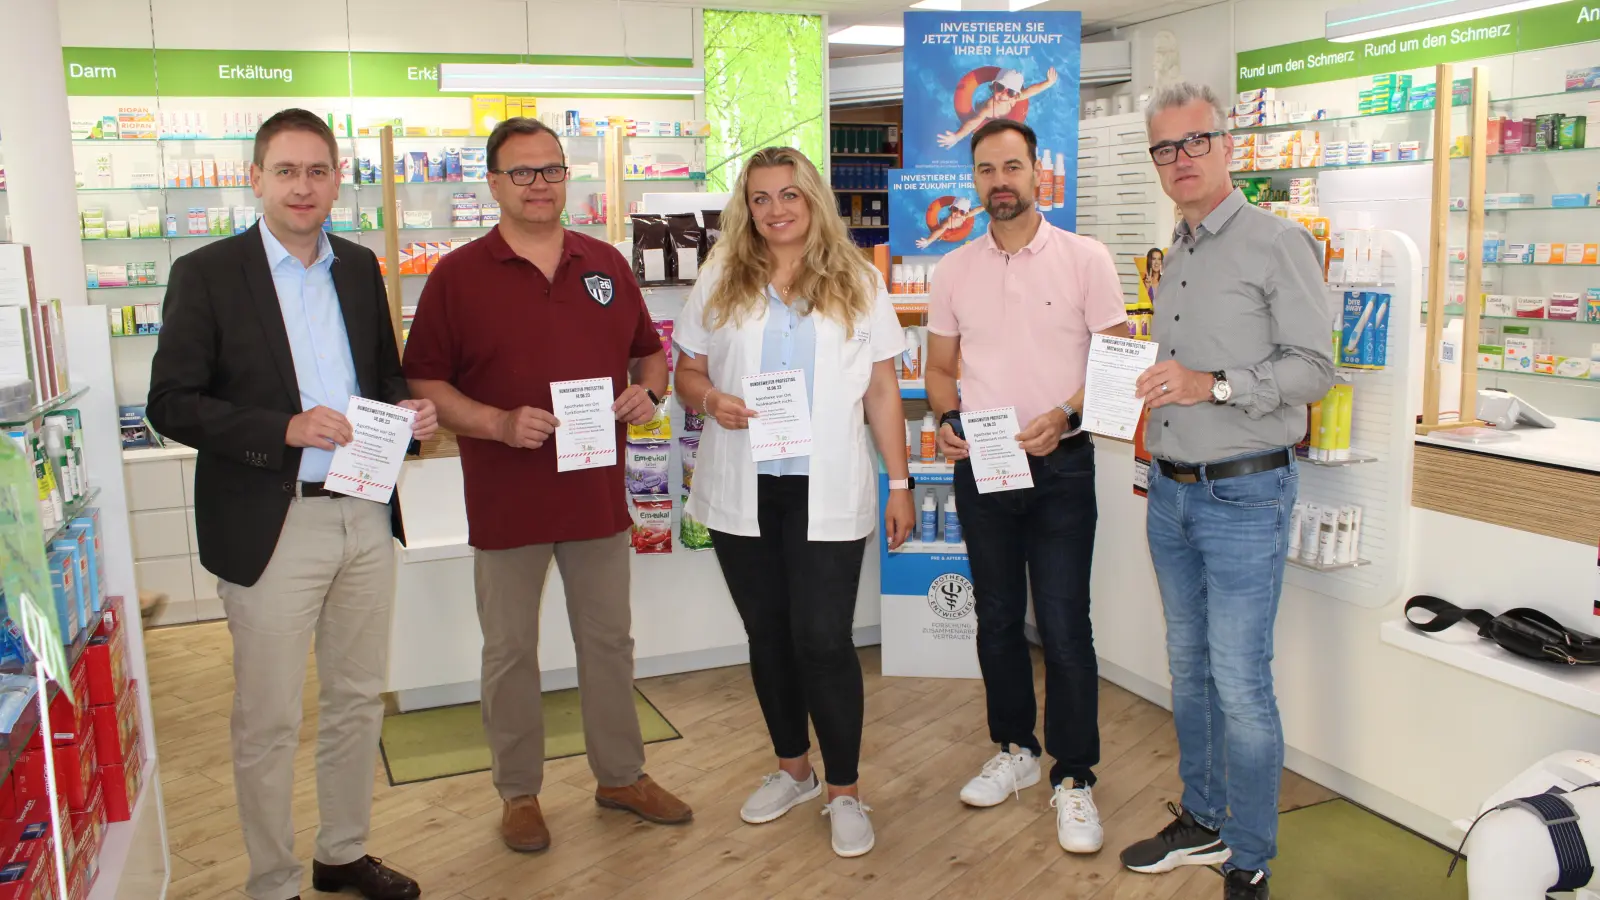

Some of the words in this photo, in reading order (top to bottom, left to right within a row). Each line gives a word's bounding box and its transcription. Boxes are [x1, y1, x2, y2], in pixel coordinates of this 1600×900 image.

[940, 22, 1022, 33] INVESTIEREN
[1026, 22, 1045, 32] SIE
[922, 34, 958, 44] JETZT
[961, 34, 975, 44] IN
[980, 34, 1000, 44] DIE
[1003, 34, 1062, 44] ZUKUNFT
[1364, 41, 1396, 58] Rund
[1399, 39, 1419, 53] um
[1426, 33, 1447, 49] den
[1450, 22, 1511, 46] Schmerz
[954, 46, 992, 56] IHRER
[996, 45, 1030, 56] HAUT
[1240, 65, 1265, 80] Rund
[1267, 63, 1284, 75] um
[1285, 58, 1305, 72] den
[1307, 50, 1355, 70] Schmerz
[69, 63, 117, 79] Darm
[218, 64, 293, 83] Erkältung
[901, 173, 956, 182] INVESTIEREN
[959, 173, 972, 181] SIE
[919, 182, 957, 190] ZUKUNFT
[600, 281, 611, 289] 26
[634, 454, 667, 462] Em-eukal
[640, 511, 670, 519] Em-eukal
[931, 574, 972, 591] APOTHEKER
[930, 600, 973, 618] ENTWICKLER
